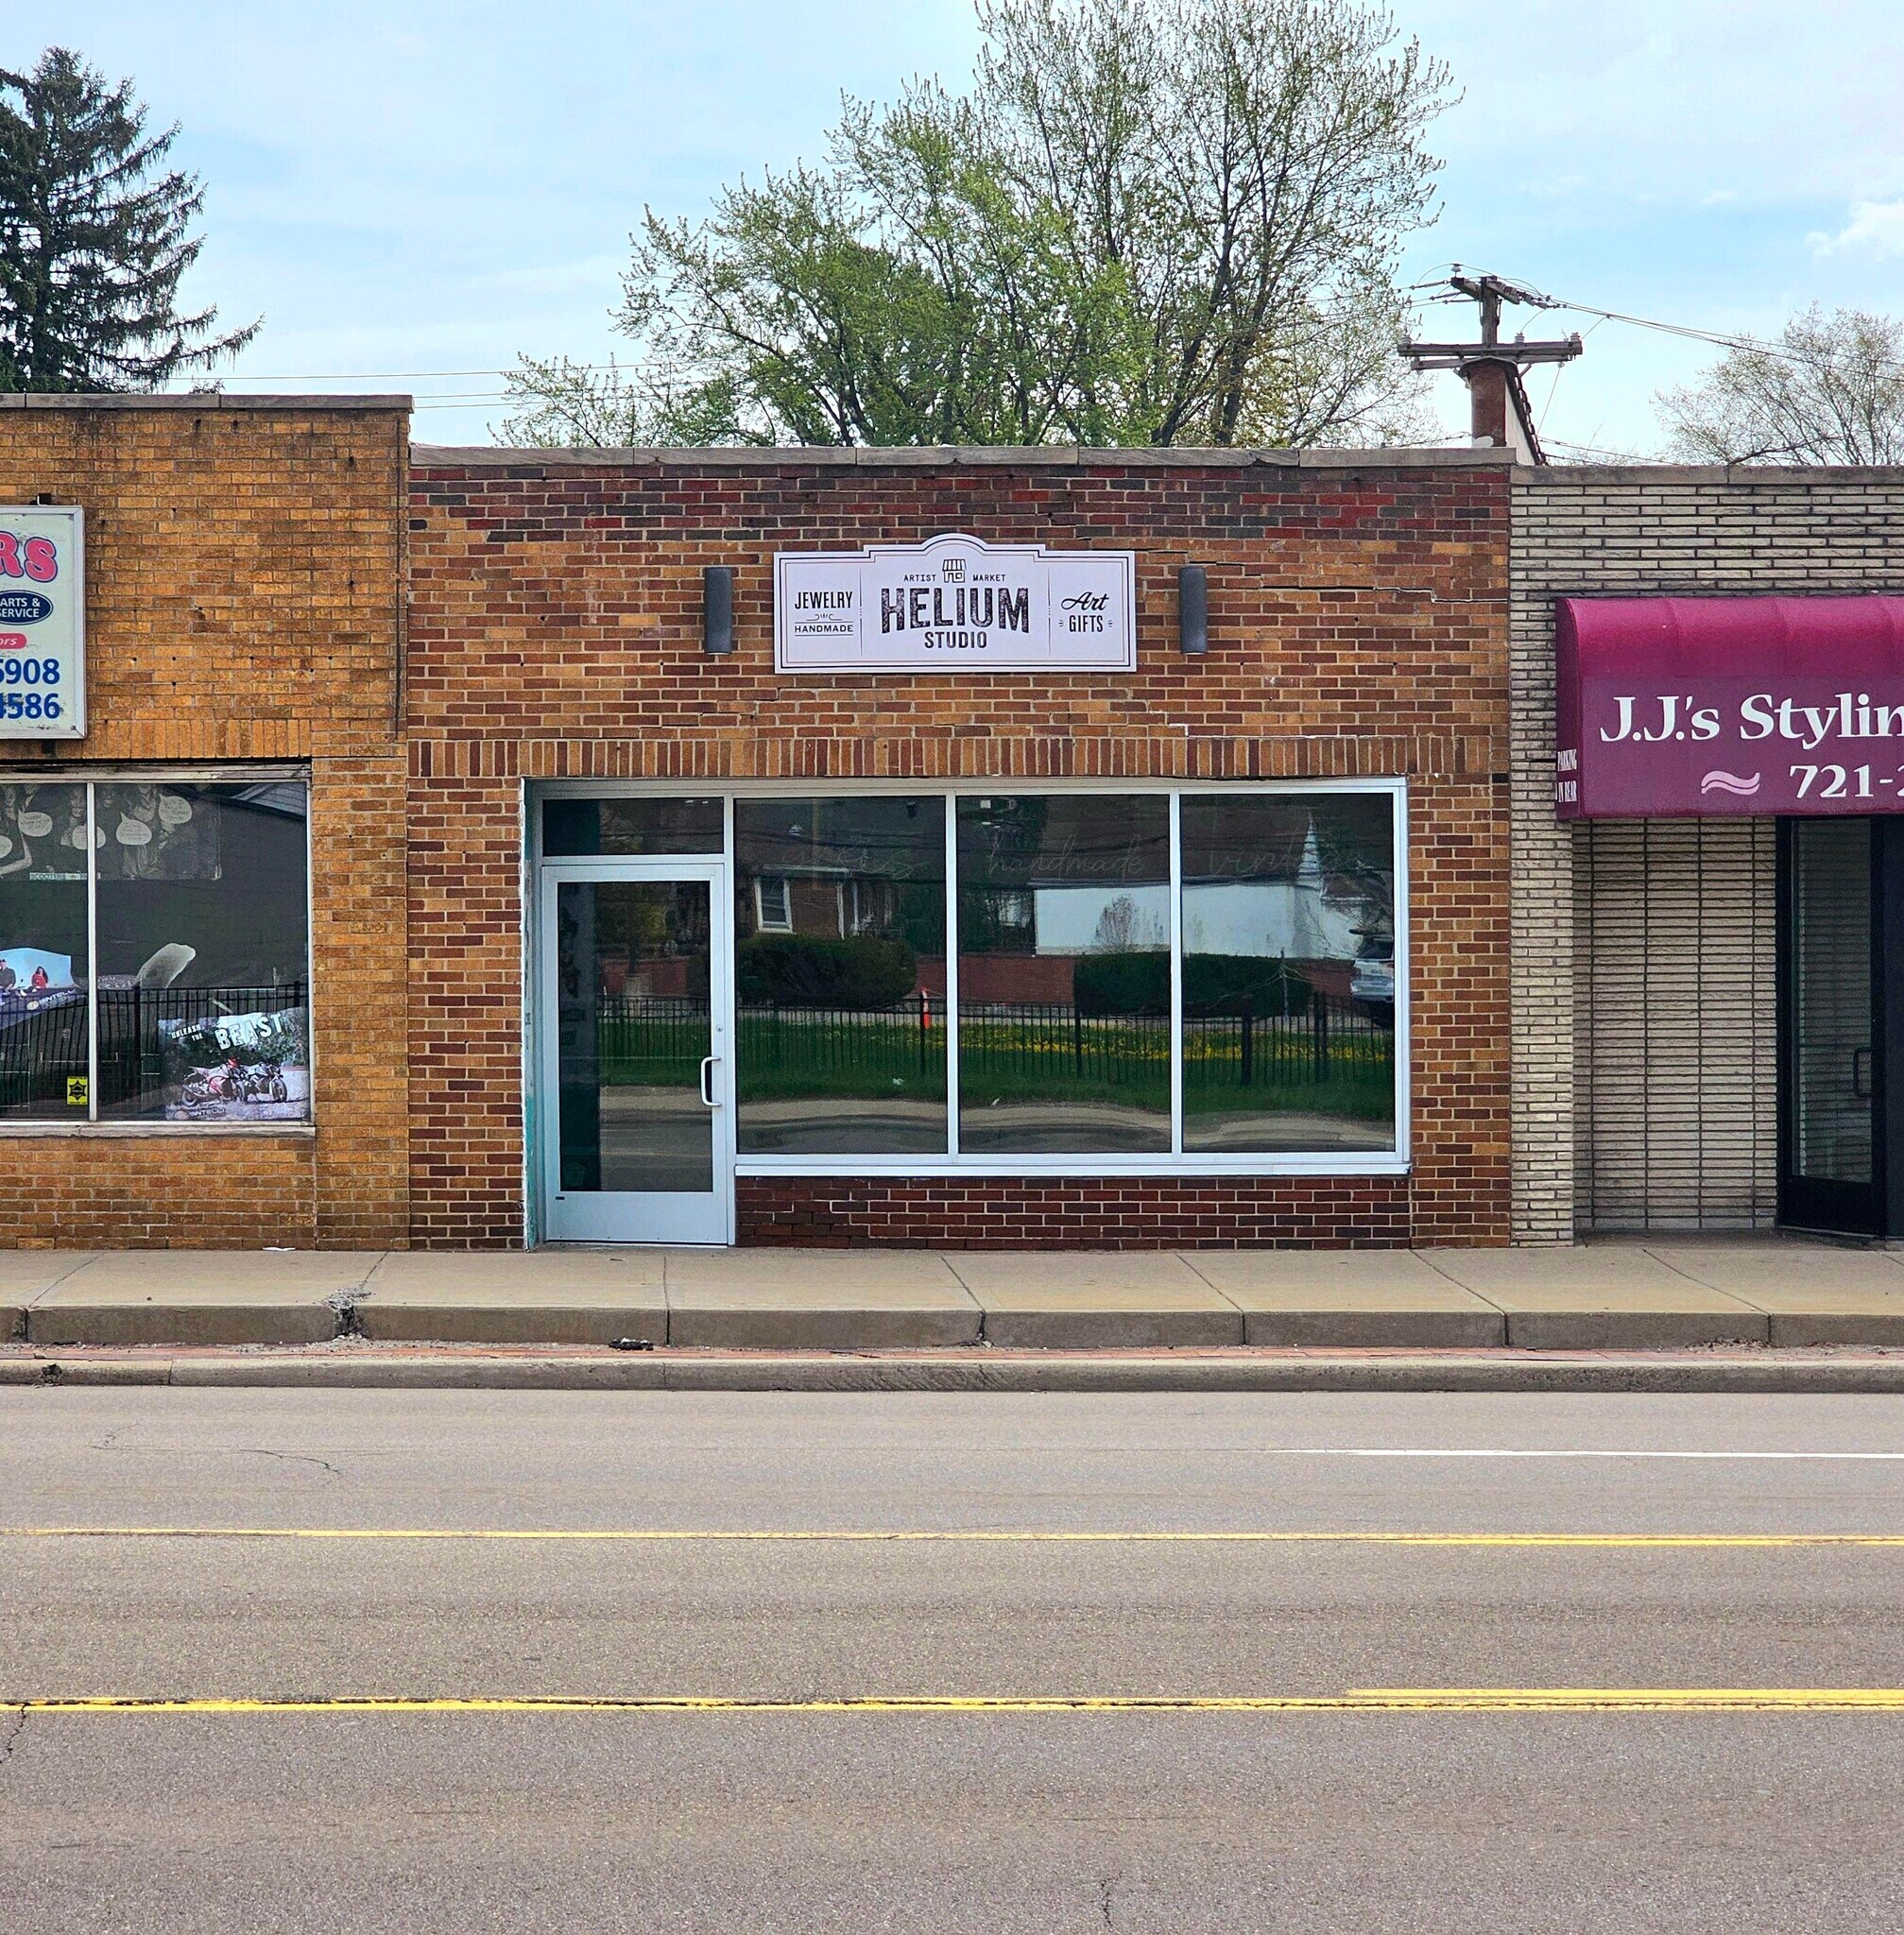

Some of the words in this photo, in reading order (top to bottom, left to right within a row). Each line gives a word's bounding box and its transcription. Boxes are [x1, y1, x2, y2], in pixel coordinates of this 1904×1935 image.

[903, 574, 936, 582] ARTIST
[972, 574, 1006, 582] MARKET
[32, 597, 41, 608] &
[794, 591, 853, 609] JEWELRY
[1060, 591, 1110, 611] Art
[0, 608, 40, 618] ERVICE
[881, 587, 1029, 634] HELIUM
[794, 624, 854, 633] HANDMADE
[1069, 615, 1104, 633] GIFTS
[924, 630, 987, 649] STUDIO
[1600, 695, 1721, 742] J.J.'s
[1740, 693, 1904, 750] Stylin
[1789, 763, 1904, 799] 721-
[171, 1023, 201, 1039] UNLEASH
[214, 1012, 283, 1051] BEAST
